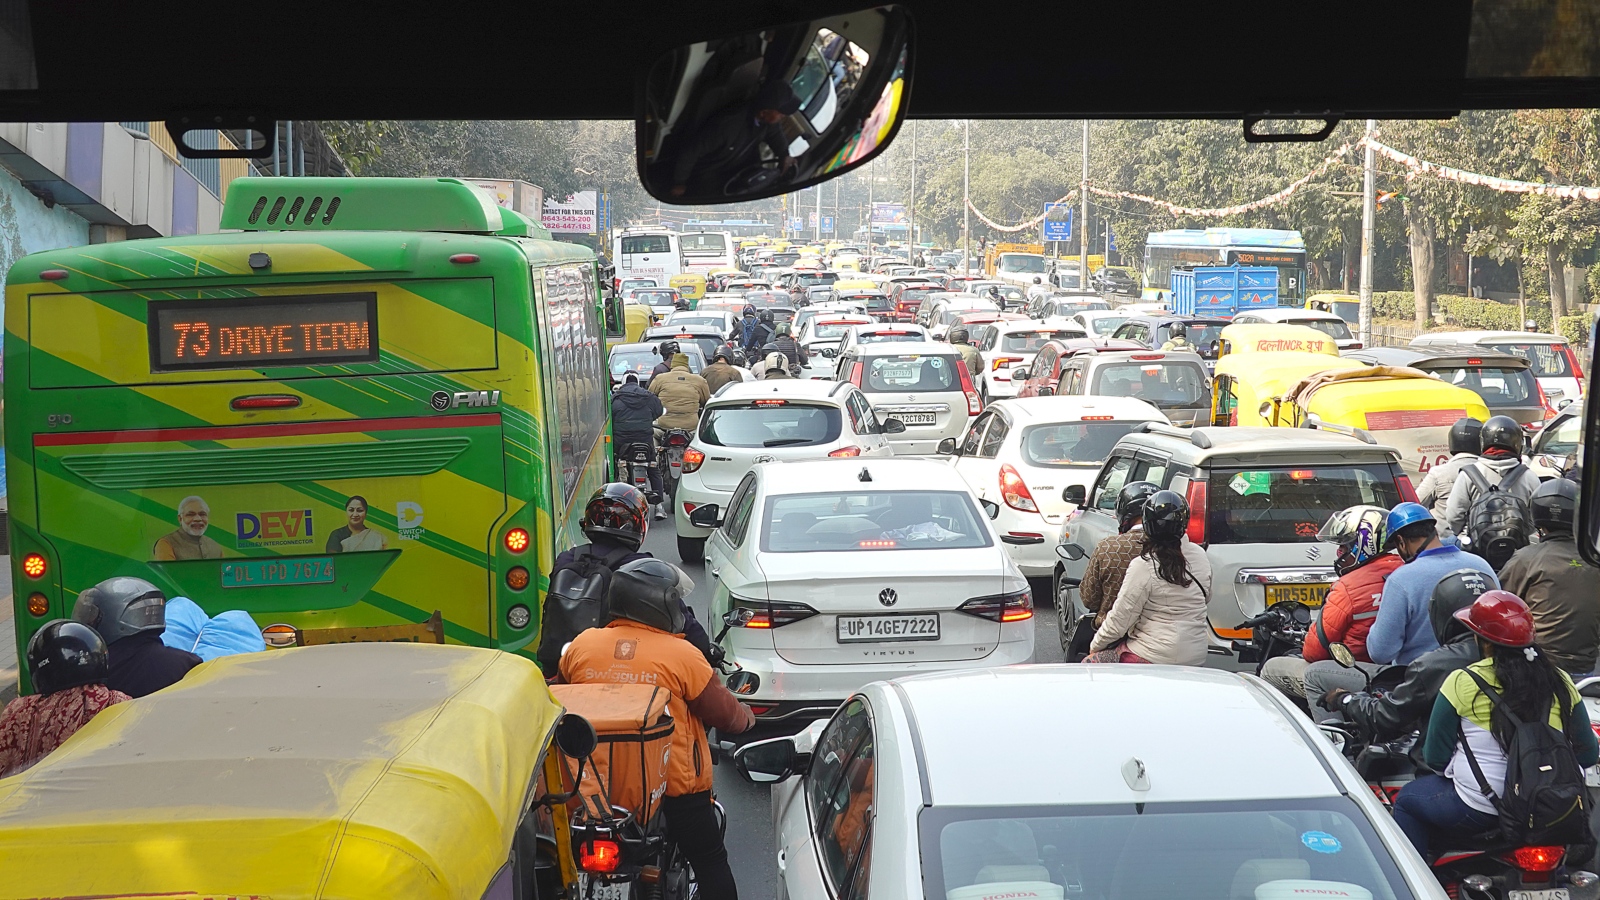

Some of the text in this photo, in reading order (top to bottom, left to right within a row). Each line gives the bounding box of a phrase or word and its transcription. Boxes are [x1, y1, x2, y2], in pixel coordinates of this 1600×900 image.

[173, 322, 210, 357] 73
[452, 390, 500, 408] PMI
[234, 566, 253, 582] DL
[261, 564, 287, 580] 1PD
[293, 562, 331, 578] 7674
[848, 619, 936, 636] UP14GE7222
[585, 667, 658, 685] Swiggy it!
[982, 892, 1038, 900] HONDA
[1293, 889, 1350, 897] HONDA
